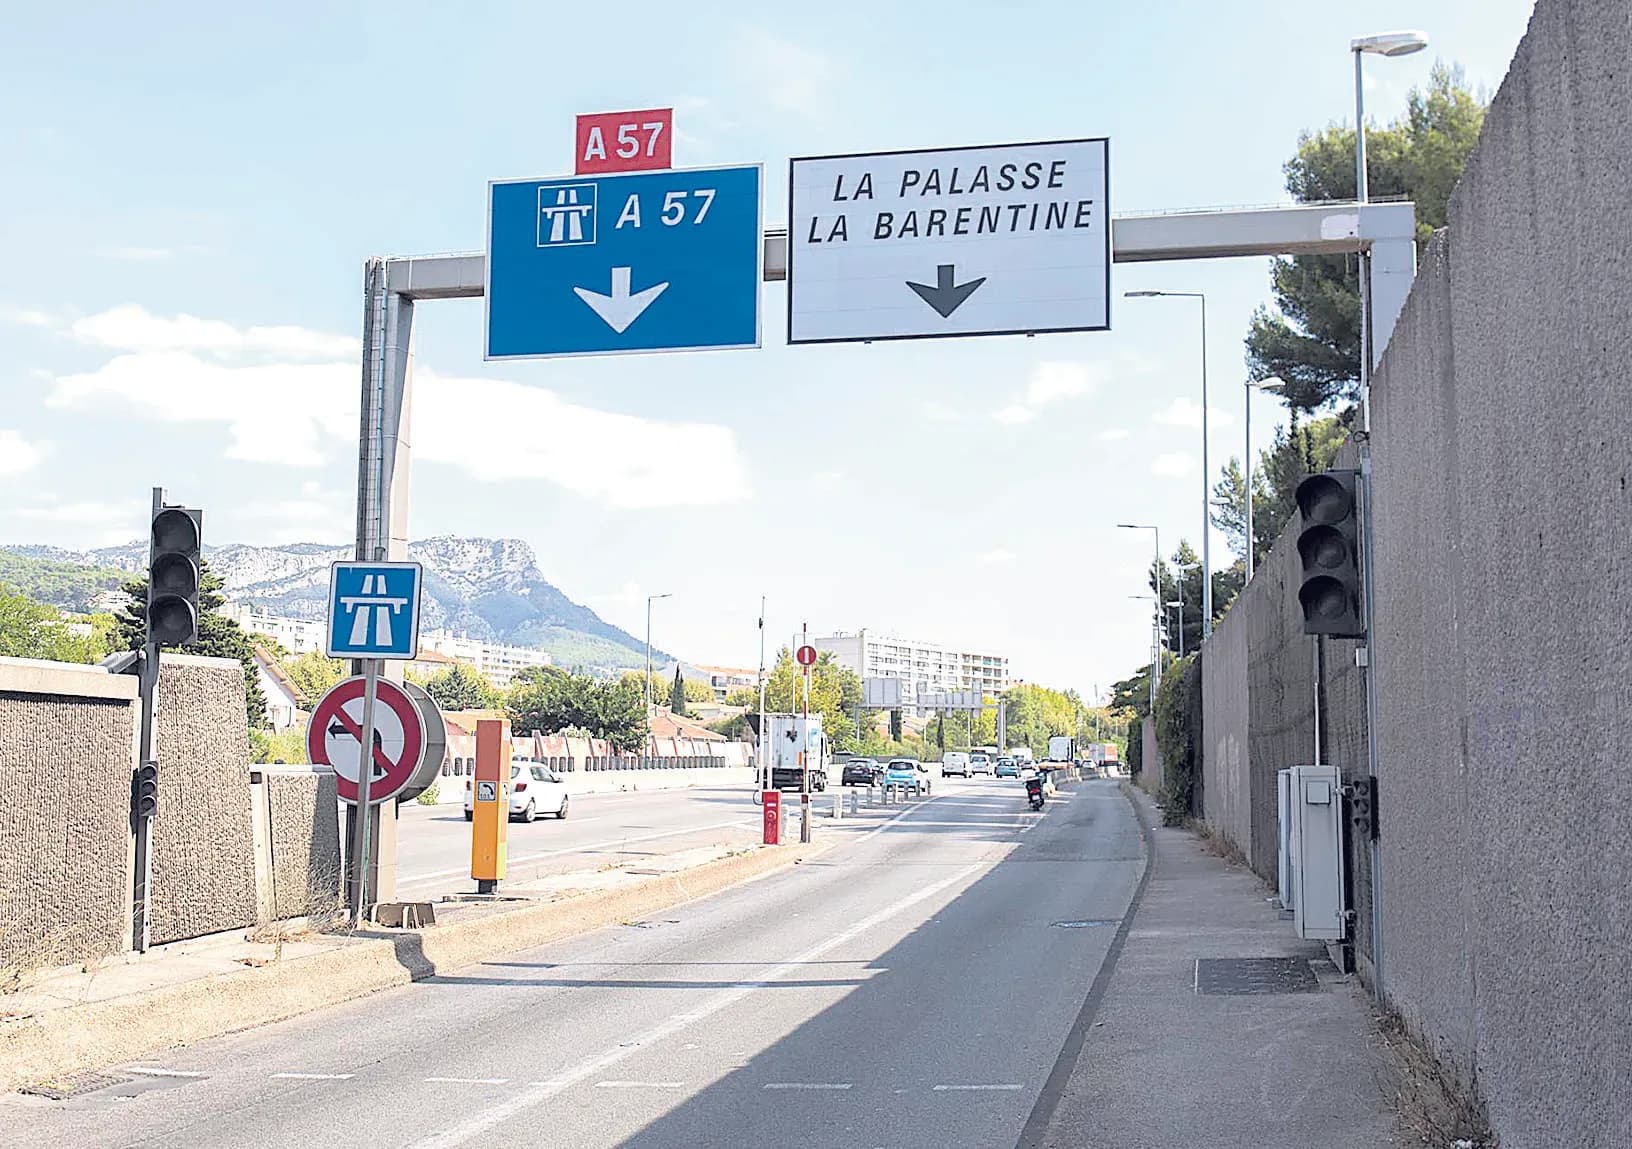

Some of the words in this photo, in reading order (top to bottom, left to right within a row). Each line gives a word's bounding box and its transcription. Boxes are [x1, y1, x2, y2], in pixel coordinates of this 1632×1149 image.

[584, 126, 606, 161] A
[616, 121, 664, 158] 57
[833, 174, 874, 202] LA
[899, 160, 1067, 198] PALASSE
[615, 194, 641, 229] A
[660, 189, 717, 226] 57
[807, 215, 848, 243] LA
[873, 200, 1094, 240] BARENTINE
